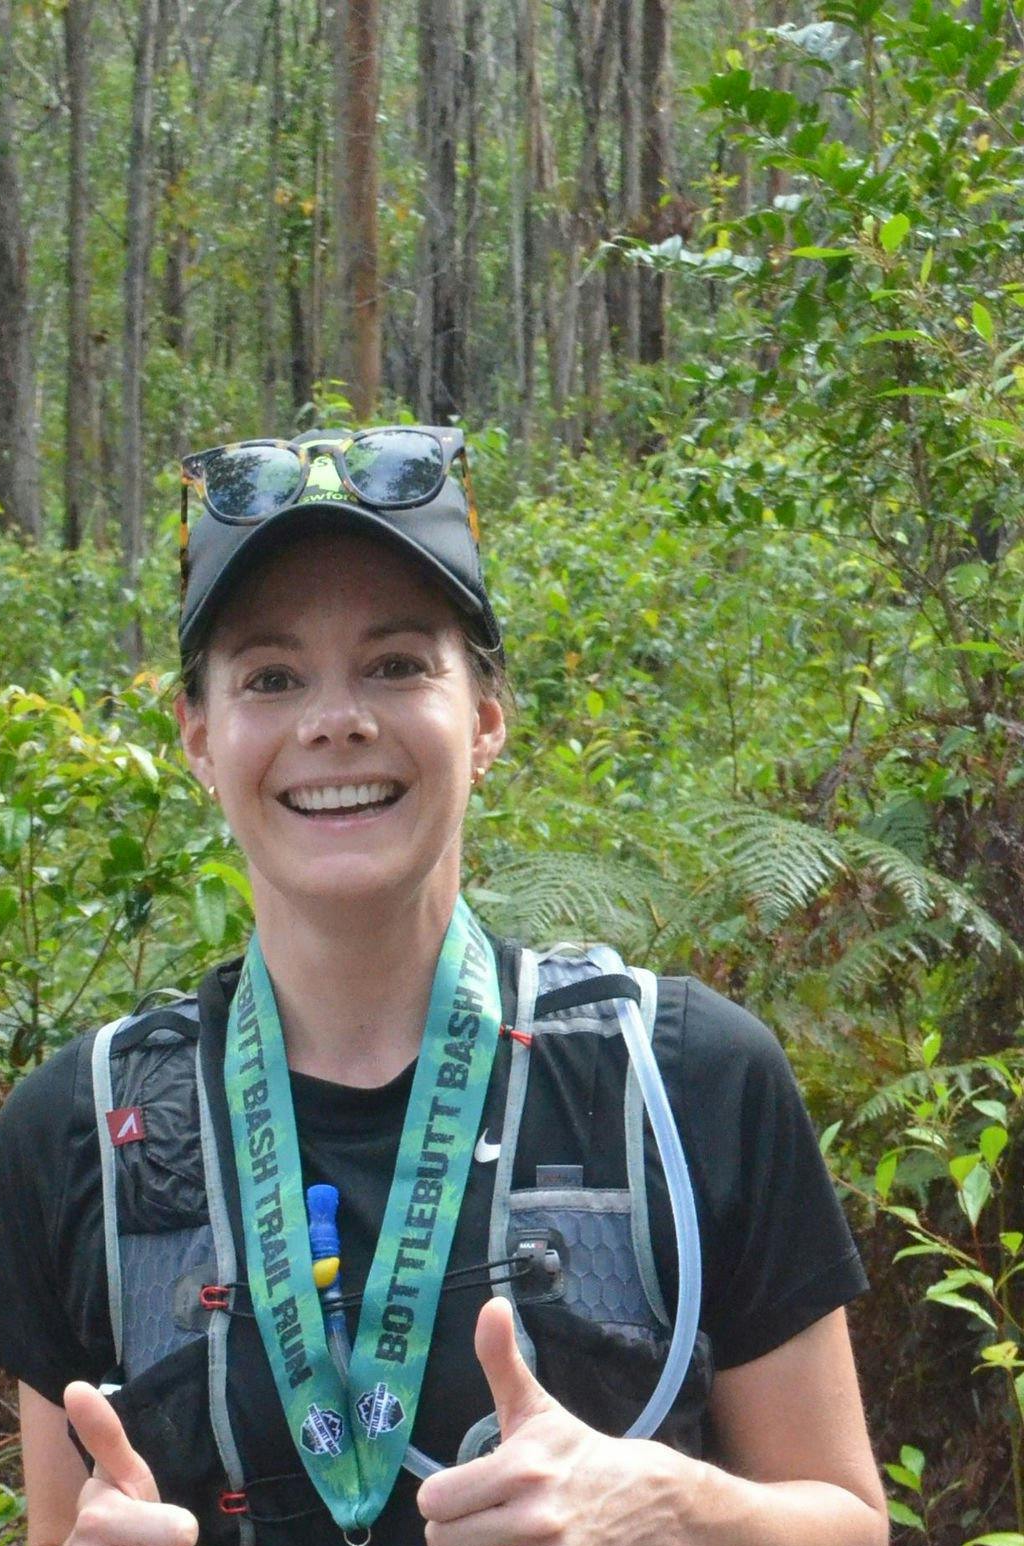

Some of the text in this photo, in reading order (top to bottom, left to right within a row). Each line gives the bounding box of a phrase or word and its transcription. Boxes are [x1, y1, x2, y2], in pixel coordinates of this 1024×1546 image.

[242, 1078, 278, 1187] BASH
[375, 1096, 461, 1365] BOTTLEBUTT
[436, 985, 485, 1092] BASH
[254, 1182, 292, 1299] TRAIL
[271, 1296, 313, 1389] RUN
